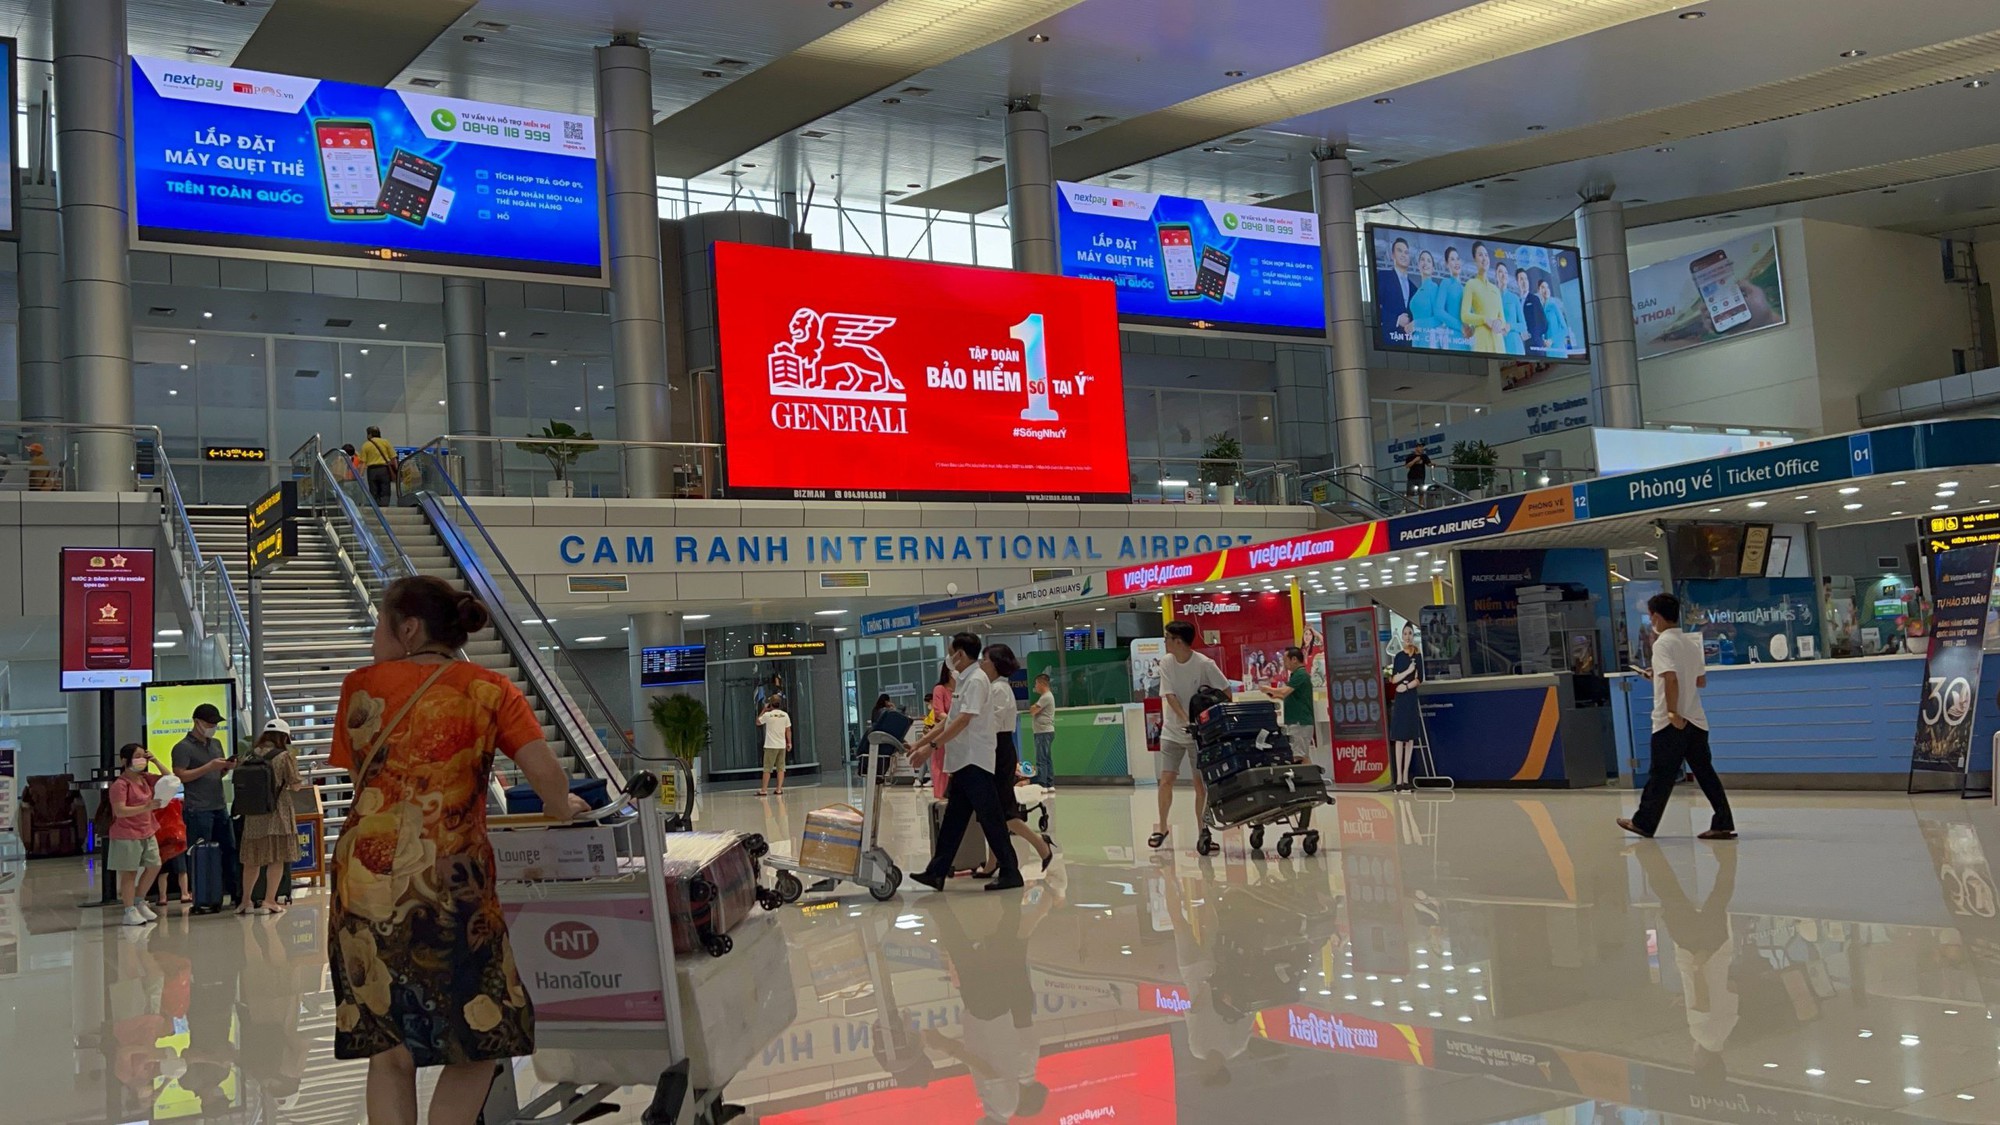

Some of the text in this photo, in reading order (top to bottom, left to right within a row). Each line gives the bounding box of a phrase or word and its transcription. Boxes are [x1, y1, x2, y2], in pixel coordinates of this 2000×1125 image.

[163, 73, 224, 91] nextpay
[195, 127, 276, 154] LẮP ĐẶT
[463, 122, 551, 142] 0848 118 999
[165, 149, 305, 177] MÁY QUẸT THẺ
[495, 172, 514, 181] TÍCH
[516, 174, 533, 184] HỢP
[553, 178, 570, 187] GÓP
[166, 180, 304, 204] TRÊN TOÀN QUỐC
[495, 186, 519, 196] CHẤP
[546, 194, 563, 203] MỌI
[564, 196, 583, 205] LOẠI
[1074, 193, 1107, 206] nextpay
[512, 199, 537, 209] NGÂN
[538, 202, 563, 211] HÀNG
[1242, 221, 1294, 235] 0848 118 999
[1093, 232, 1137, 252] LẮP ĐẶT
[1077, 250, 1155, 268] MÁY QUẸT THẺ
[1128, 277, 1155, 289] QUỐC
[968, 346, 1020, 362] TẬP ĐOÀN
[1009, 313, 1059, 422] 1
[926, 361, 967, 390] BẢO
[972, 362, 1022, 393] HIỂM
[1052, 379, 1072, 399] TẠI
[770, 401, 909, 434] GENERALI
[1854, 447, 1869, 462] 01
[1629, 458, 1820, 501] Phòng vé Ticket Office
[793, 489, 826, 499] BIZMAN
[1574, 496, 1587, 508] 12
[1400, 517, 1486, 542] PACIFIC AIRLINES
[559, 534, 654, 564] CAM
[675, 535, 789, 563] RANH
[806, 534, 1103, 563] INTERNATIONAL
[1049, 583, 1081, 595] AIRWAYS
[1922, 676, 1971, 726] 30
[498, 848, 541, 865] Lounge
[550, 929, 593, 951] HNT
[536, 970, 623, 989] HanaTour
